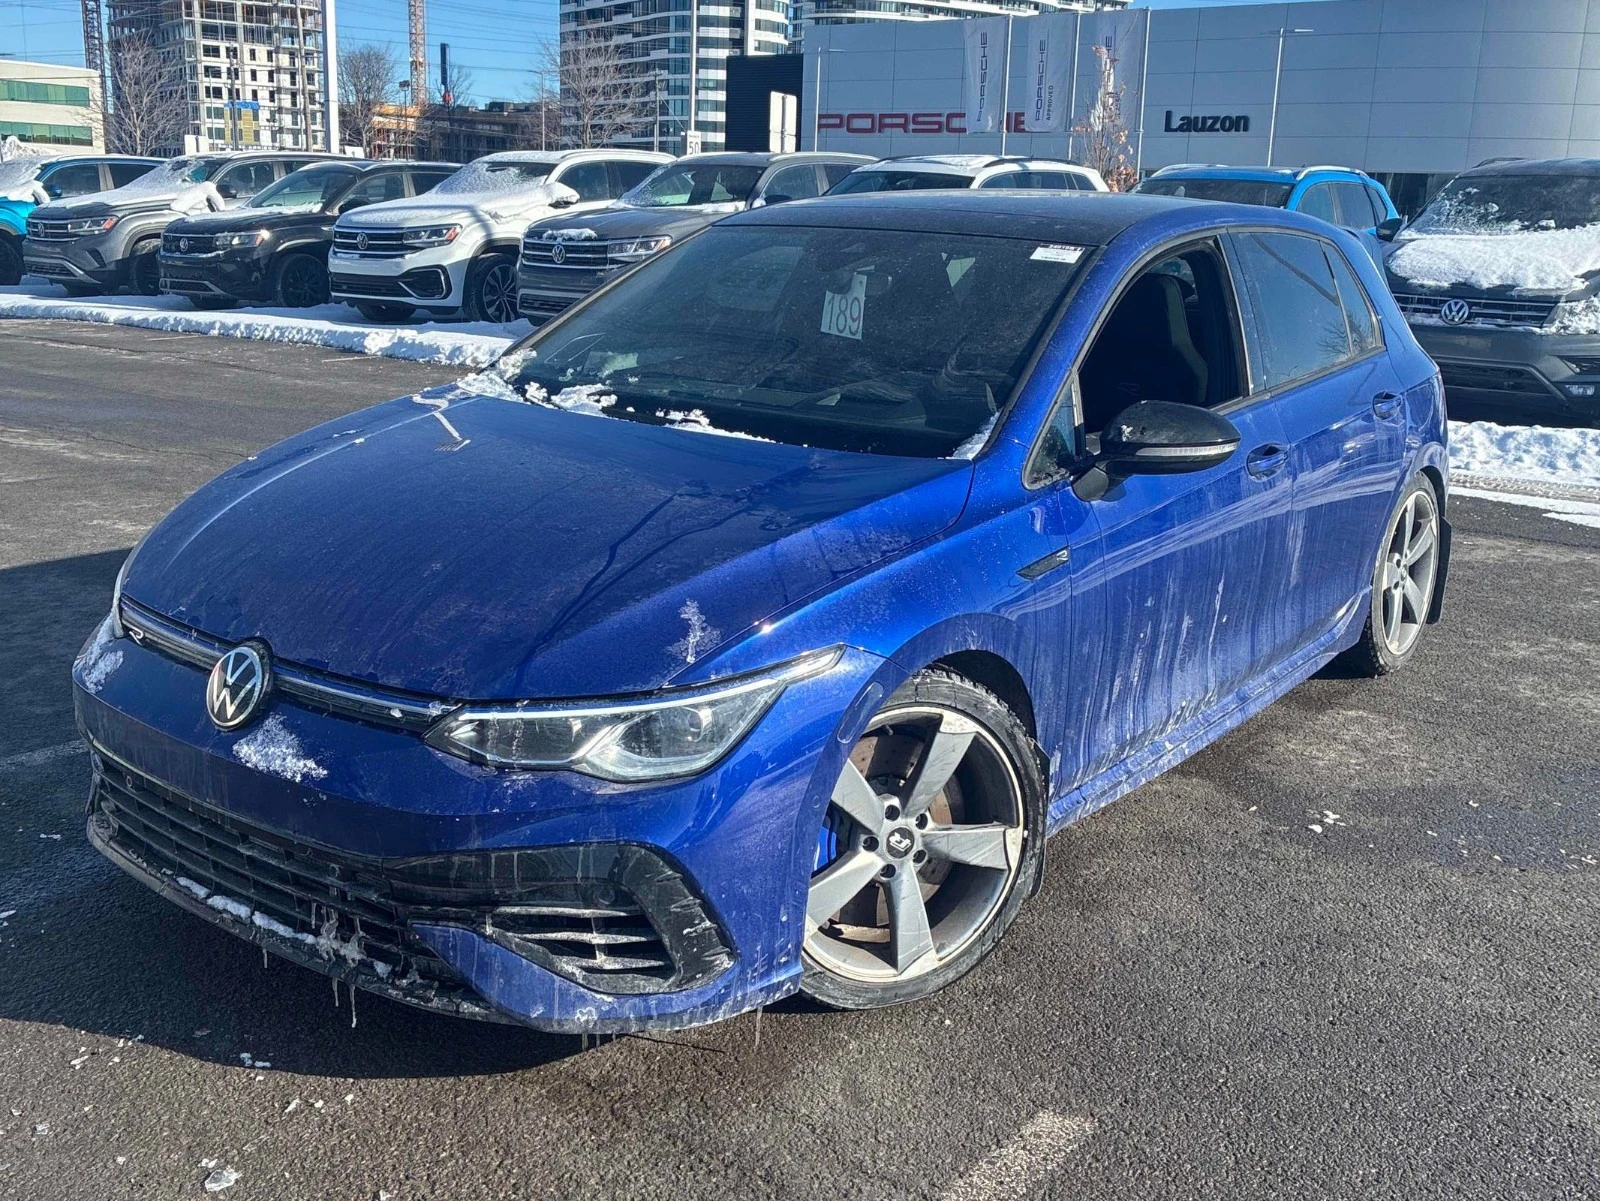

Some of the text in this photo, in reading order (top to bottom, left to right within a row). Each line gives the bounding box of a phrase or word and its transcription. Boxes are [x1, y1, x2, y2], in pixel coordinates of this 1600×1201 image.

[977, 32, 987, 121] PORSCHE
[1035, 40, 1046, 120] PORSCHE
[1046, 85, 1054, 120] APPROVED
[818, 113, 1025, 134] PORSCE
[1164, 110, 1249, 132] Lauzon
[688, 141, 700, 155] 50
[828, 294, 861, 336] 189
[126, 622, 144, 646] R
[207, 646, 262, 728] VW
